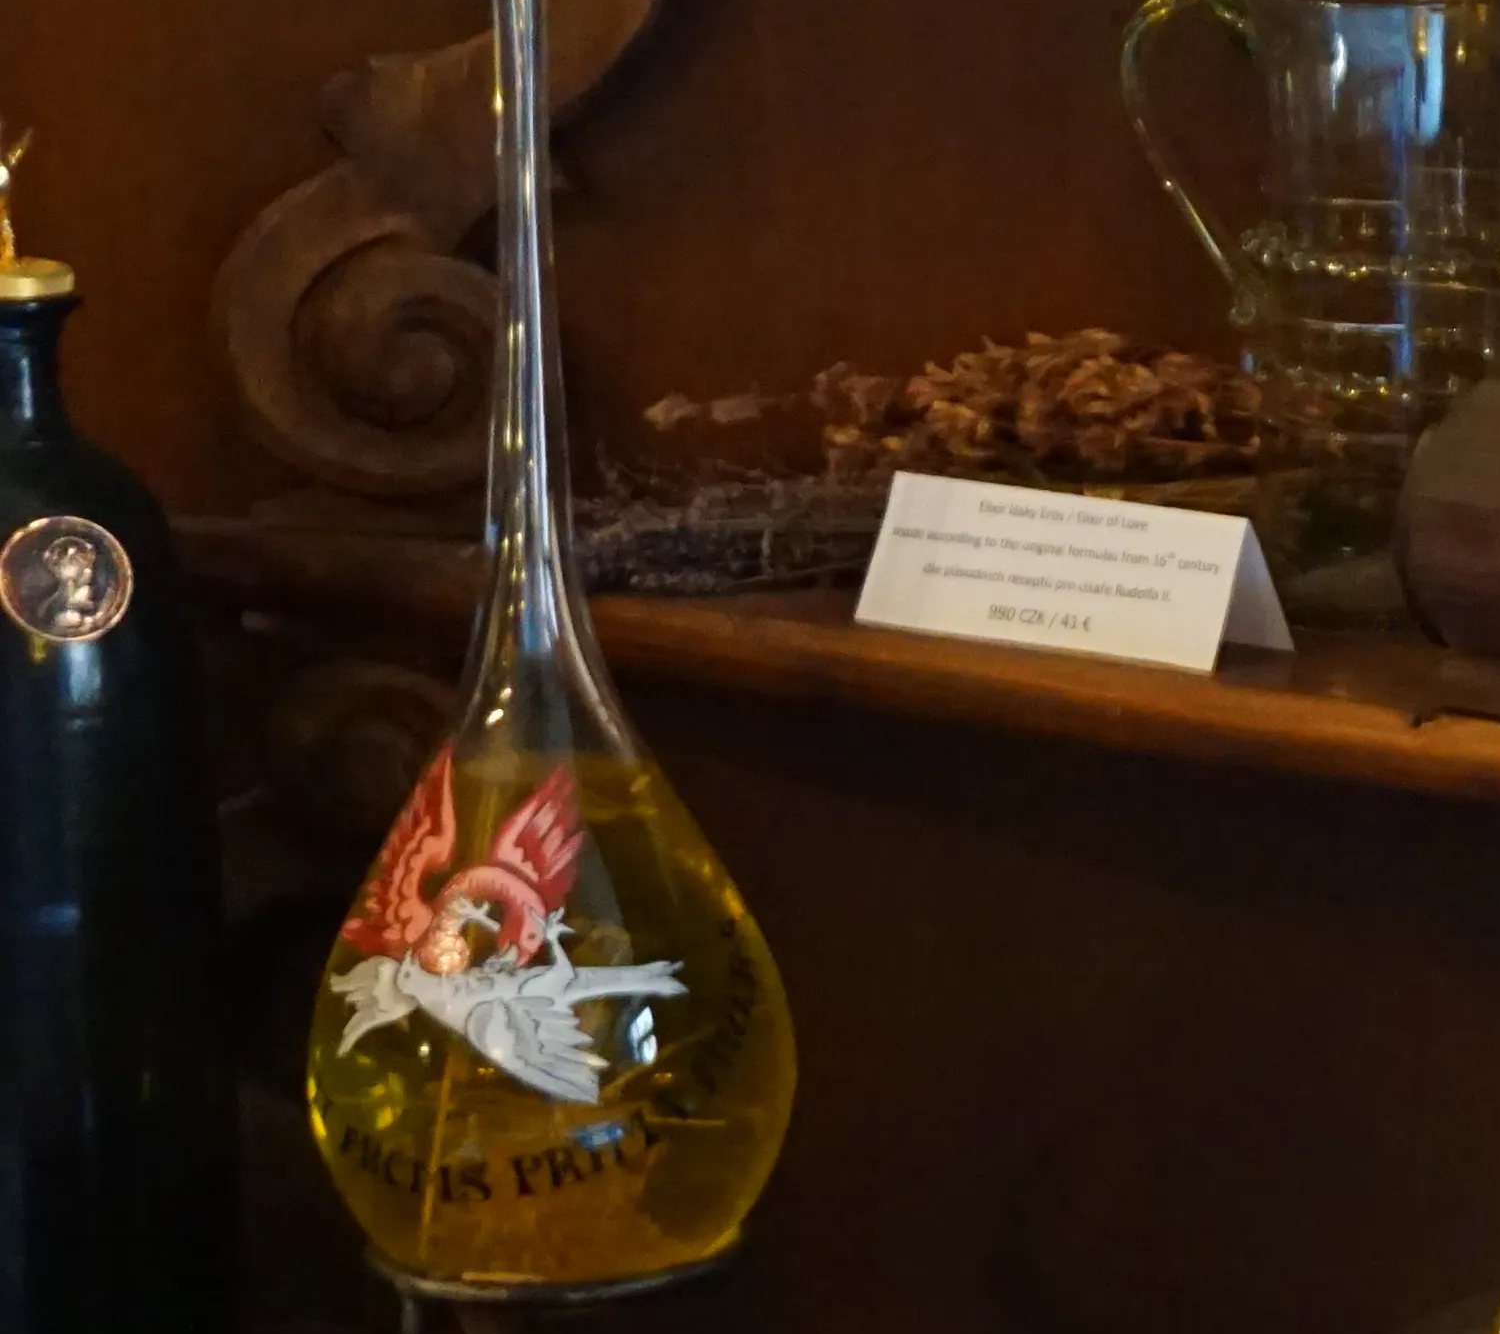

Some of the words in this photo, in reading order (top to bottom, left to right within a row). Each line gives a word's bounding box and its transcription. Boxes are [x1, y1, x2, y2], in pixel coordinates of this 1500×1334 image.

[1041, 505, 1064, 522] Eros
[1106, 513, 1120, 528] of
[1121, 516, 1148, 532] Love
[926, 527, 982, 549] according
[984, 532, 997, 548] to
[999, 534, 1019, 551] the
[1022, 536, 1066, 558] original
[1120, 547, 1150, 566] from
[1177, 555, 1220, 576] century
[1018, 607, 1045, 627] CZK
[1082, 616, 1092, 634] €
